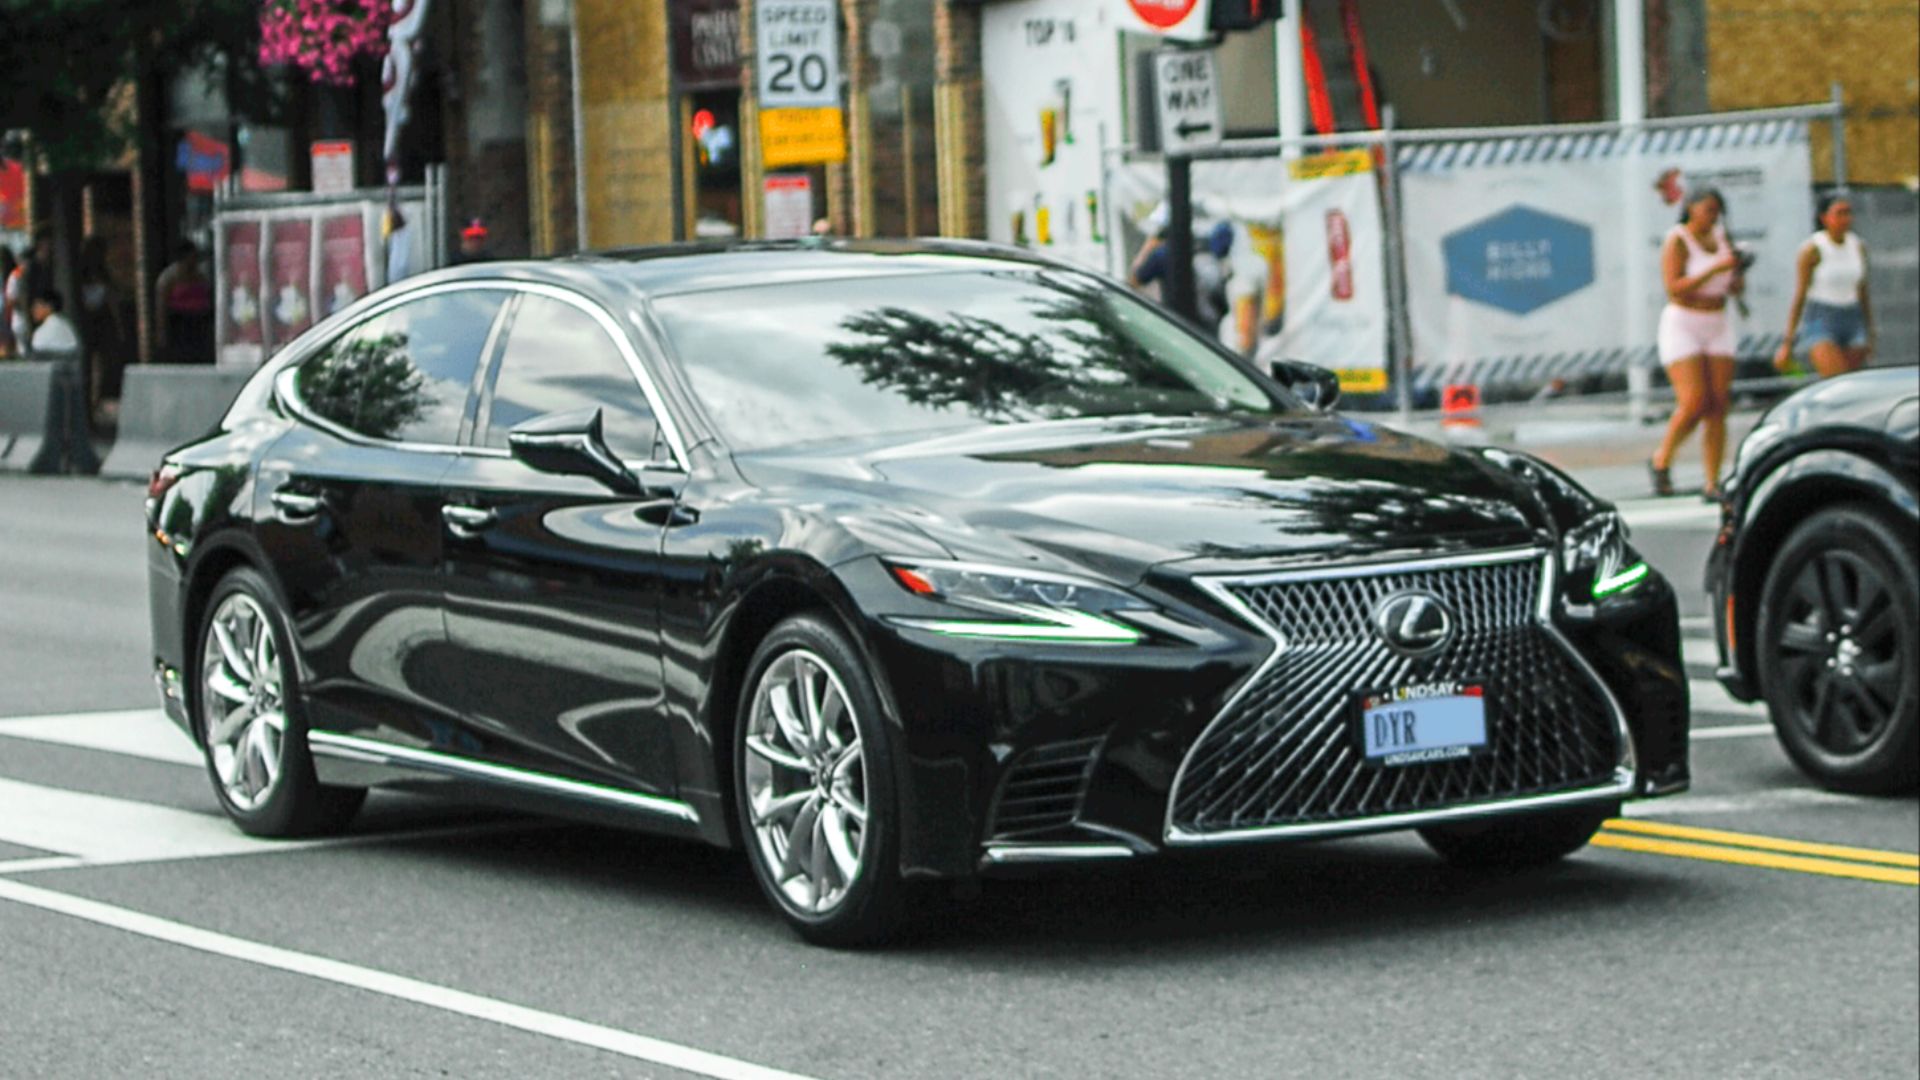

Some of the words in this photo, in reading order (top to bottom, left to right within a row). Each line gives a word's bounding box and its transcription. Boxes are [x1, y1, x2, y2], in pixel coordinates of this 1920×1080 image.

[764, 6, 827, 23] SPEED
[768, 30, 821, 47] LIMIT
[768, 53, 828, 92] 20
[1163, 56, 1209, 83] ONE
[1166, 87, 1211, 111] WAY
[1391, 681, 1455, 702] LINDSAY
[1373, 709, 1417, 748] DYR
